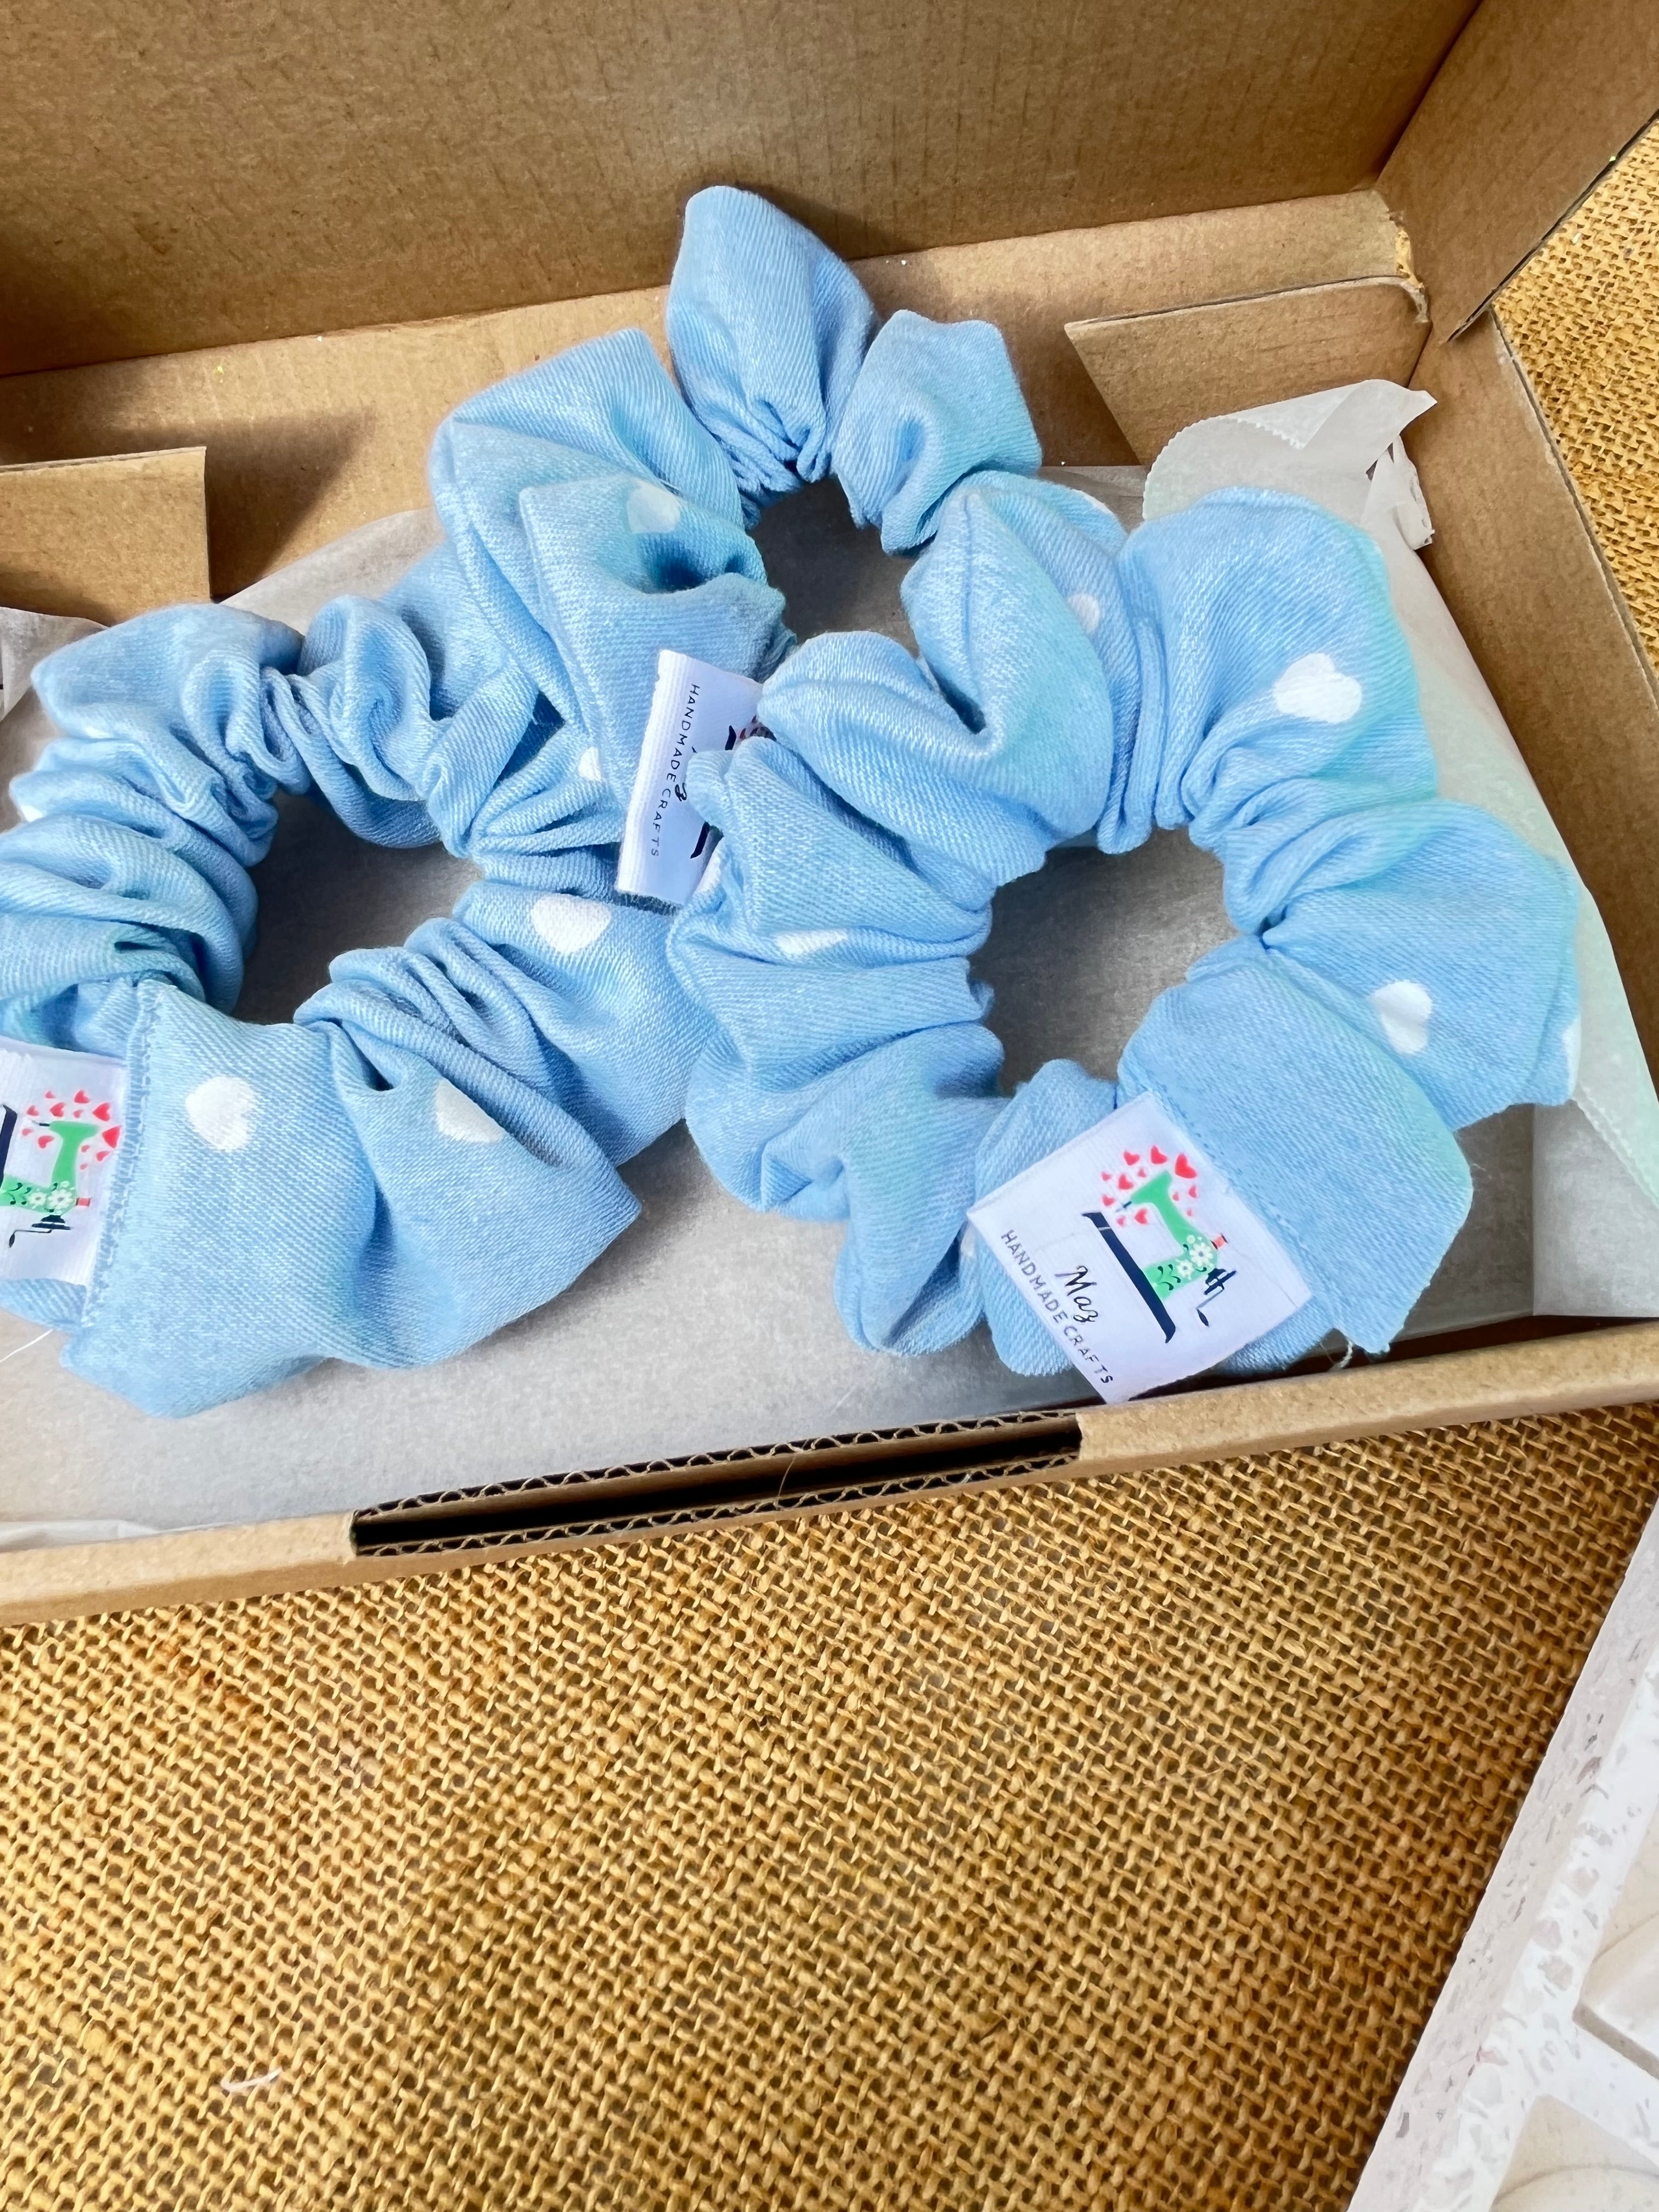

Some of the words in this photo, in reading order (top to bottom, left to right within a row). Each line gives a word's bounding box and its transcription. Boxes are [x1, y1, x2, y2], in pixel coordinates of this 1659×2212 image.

[666, 683, 701, 783] HANDMADE
[651, 788, 671, 857] CRAFTS
[1001, 1229, 1068, 1323] HANDMADE
[1063, 1325, 1114, 1384] CRAFTS
